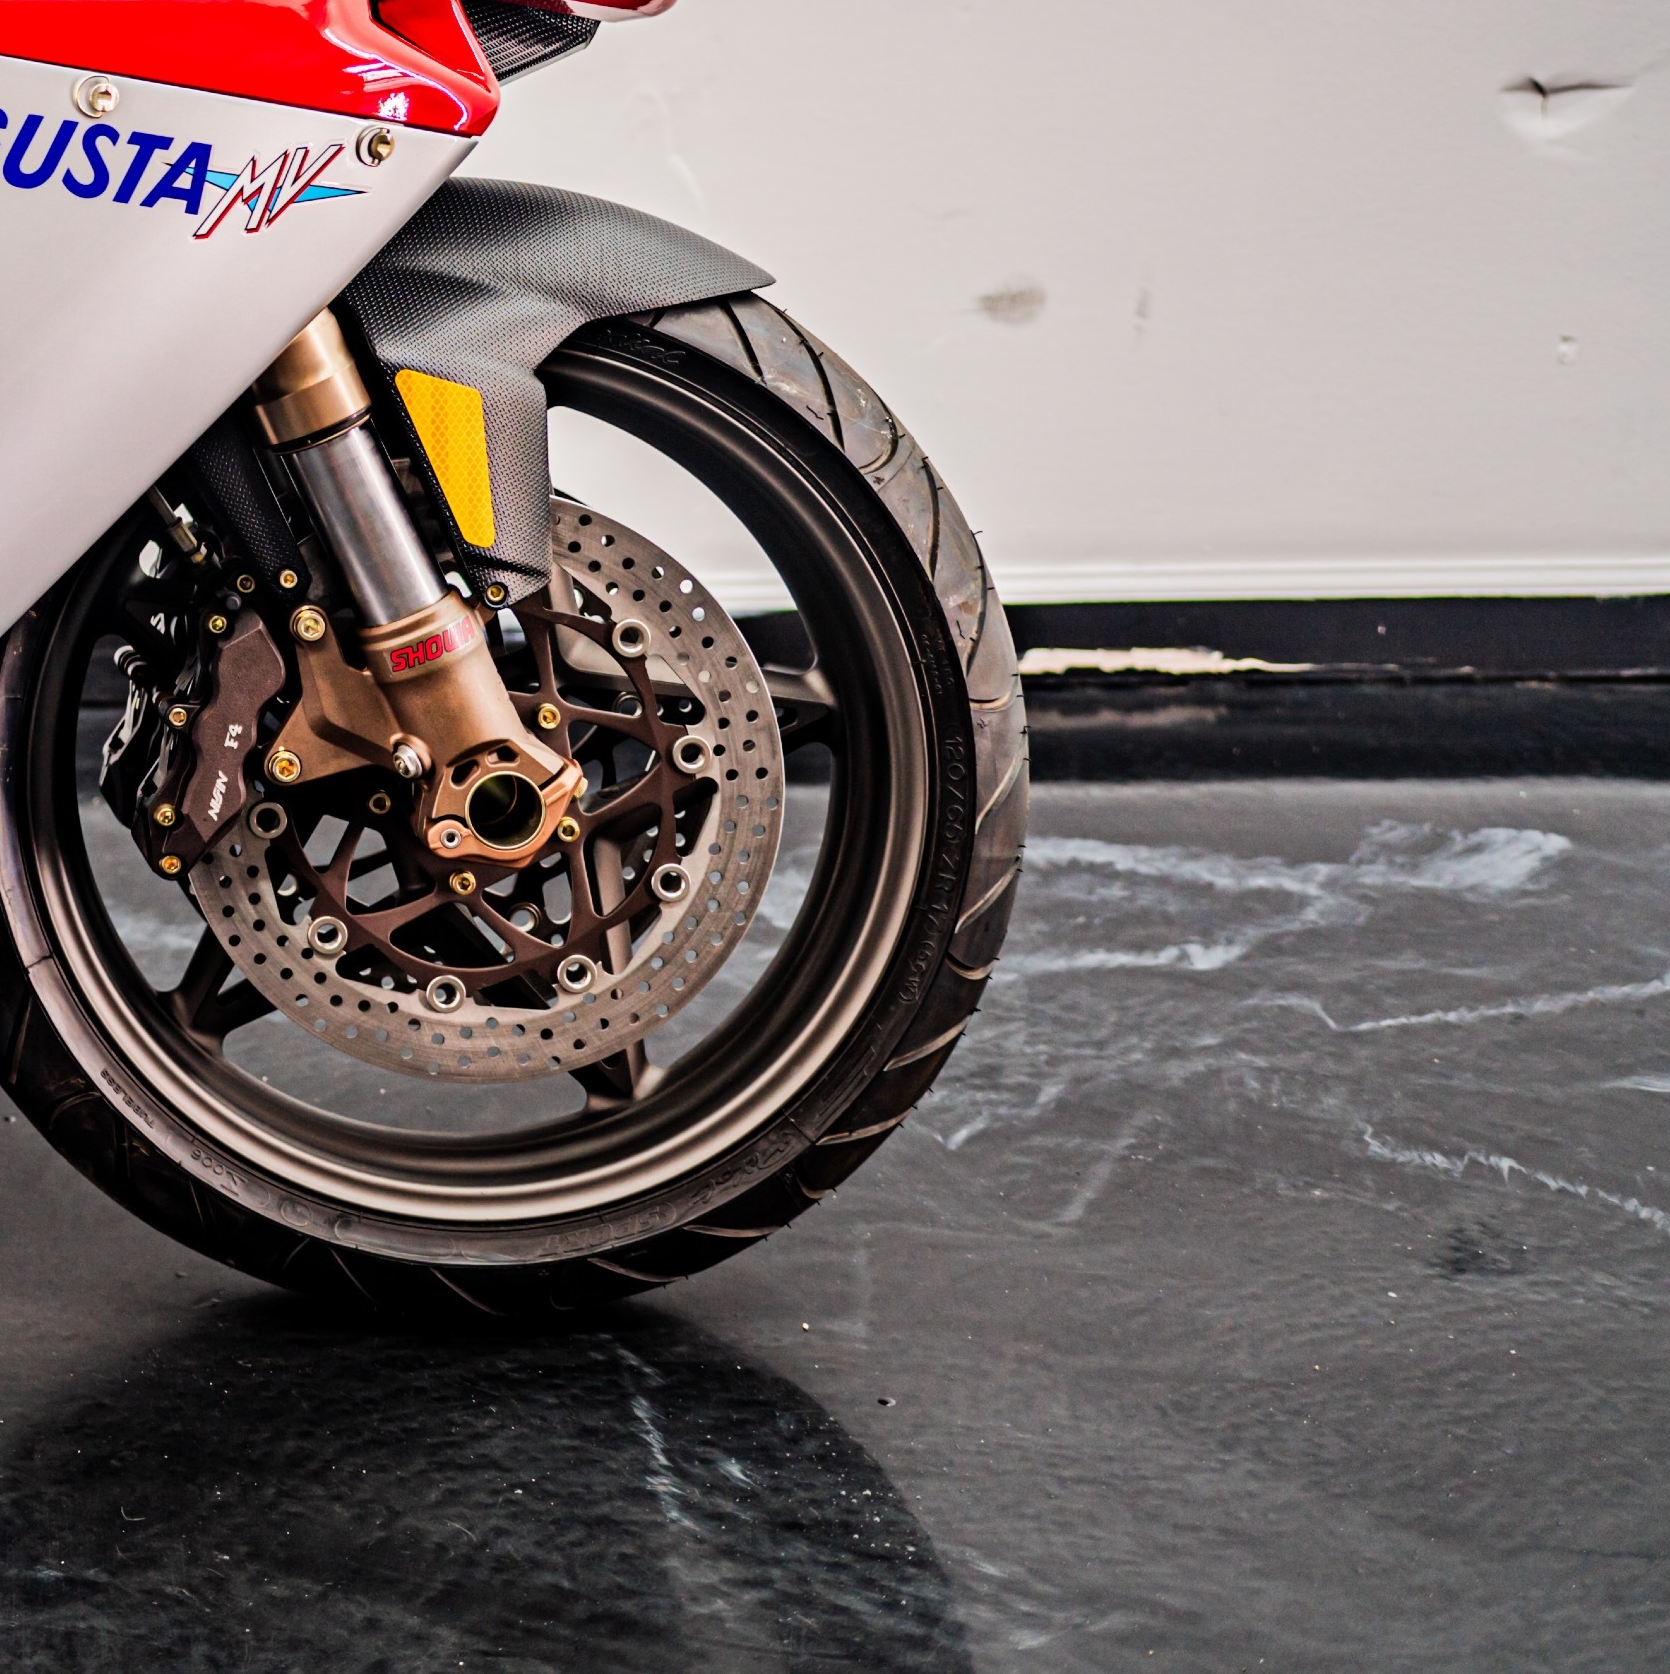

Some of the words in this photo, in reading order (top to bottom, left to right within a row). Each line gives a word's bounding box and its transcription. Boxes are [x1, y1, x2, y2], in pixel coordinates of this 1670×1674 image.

[193, 143, 345, 240] MV
[390, 615, 476, 672] SHOWA
[224, 724, 243, 750] F4
[100, 1069, 155, 1129] TUBELESS
